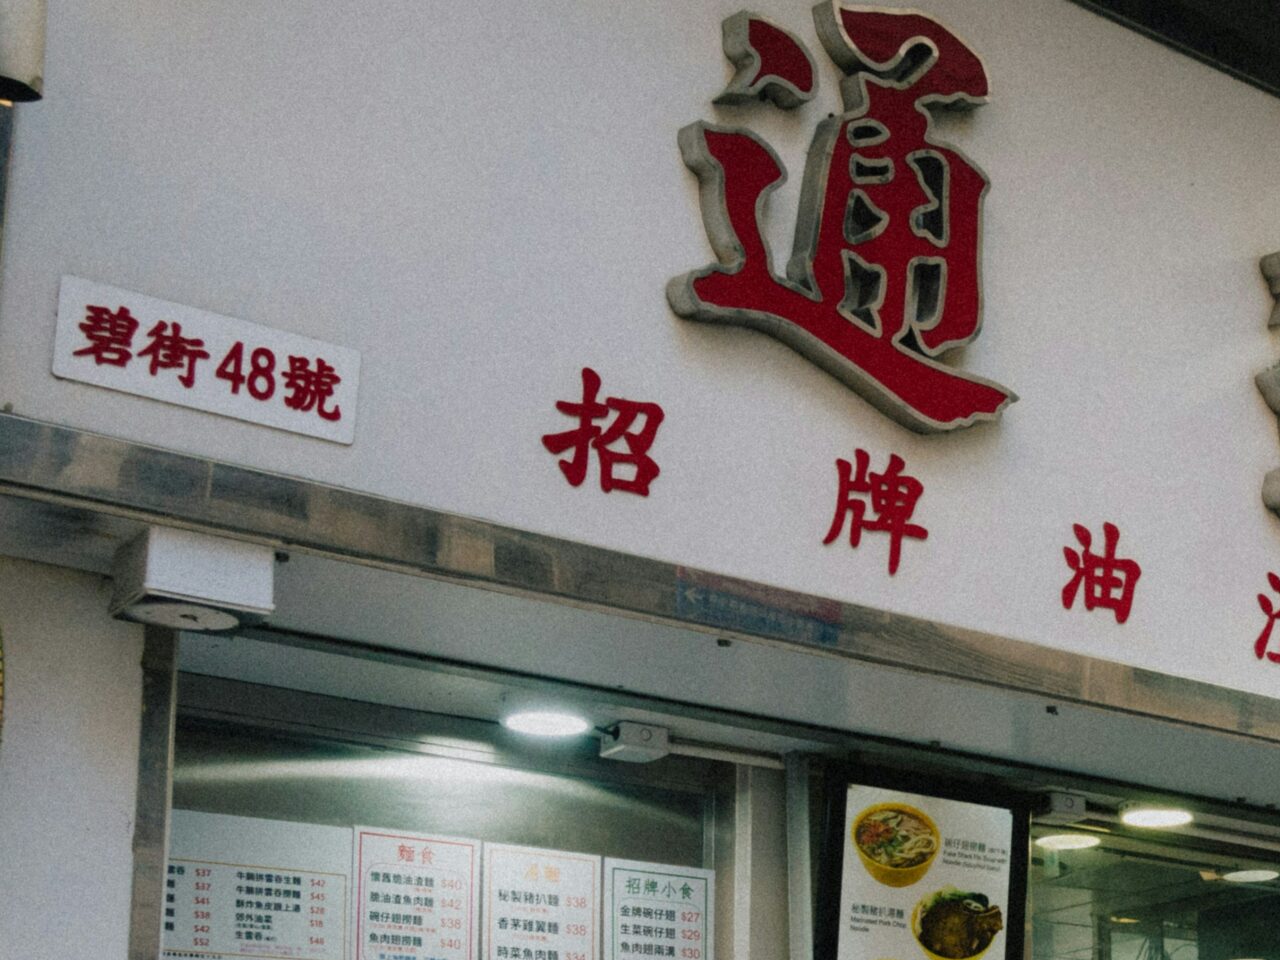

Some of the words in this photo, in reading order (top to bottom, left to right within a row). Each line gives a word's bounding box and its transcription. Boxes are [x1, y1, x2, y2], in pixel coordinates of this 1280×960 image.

[73, 304, 342, 423] 碧街48號
[625, 877, 694, 900] 招牌小食
[620, 905, 676, 922] 金牌碗仔翅
[681, 911, 700, 923] $27
